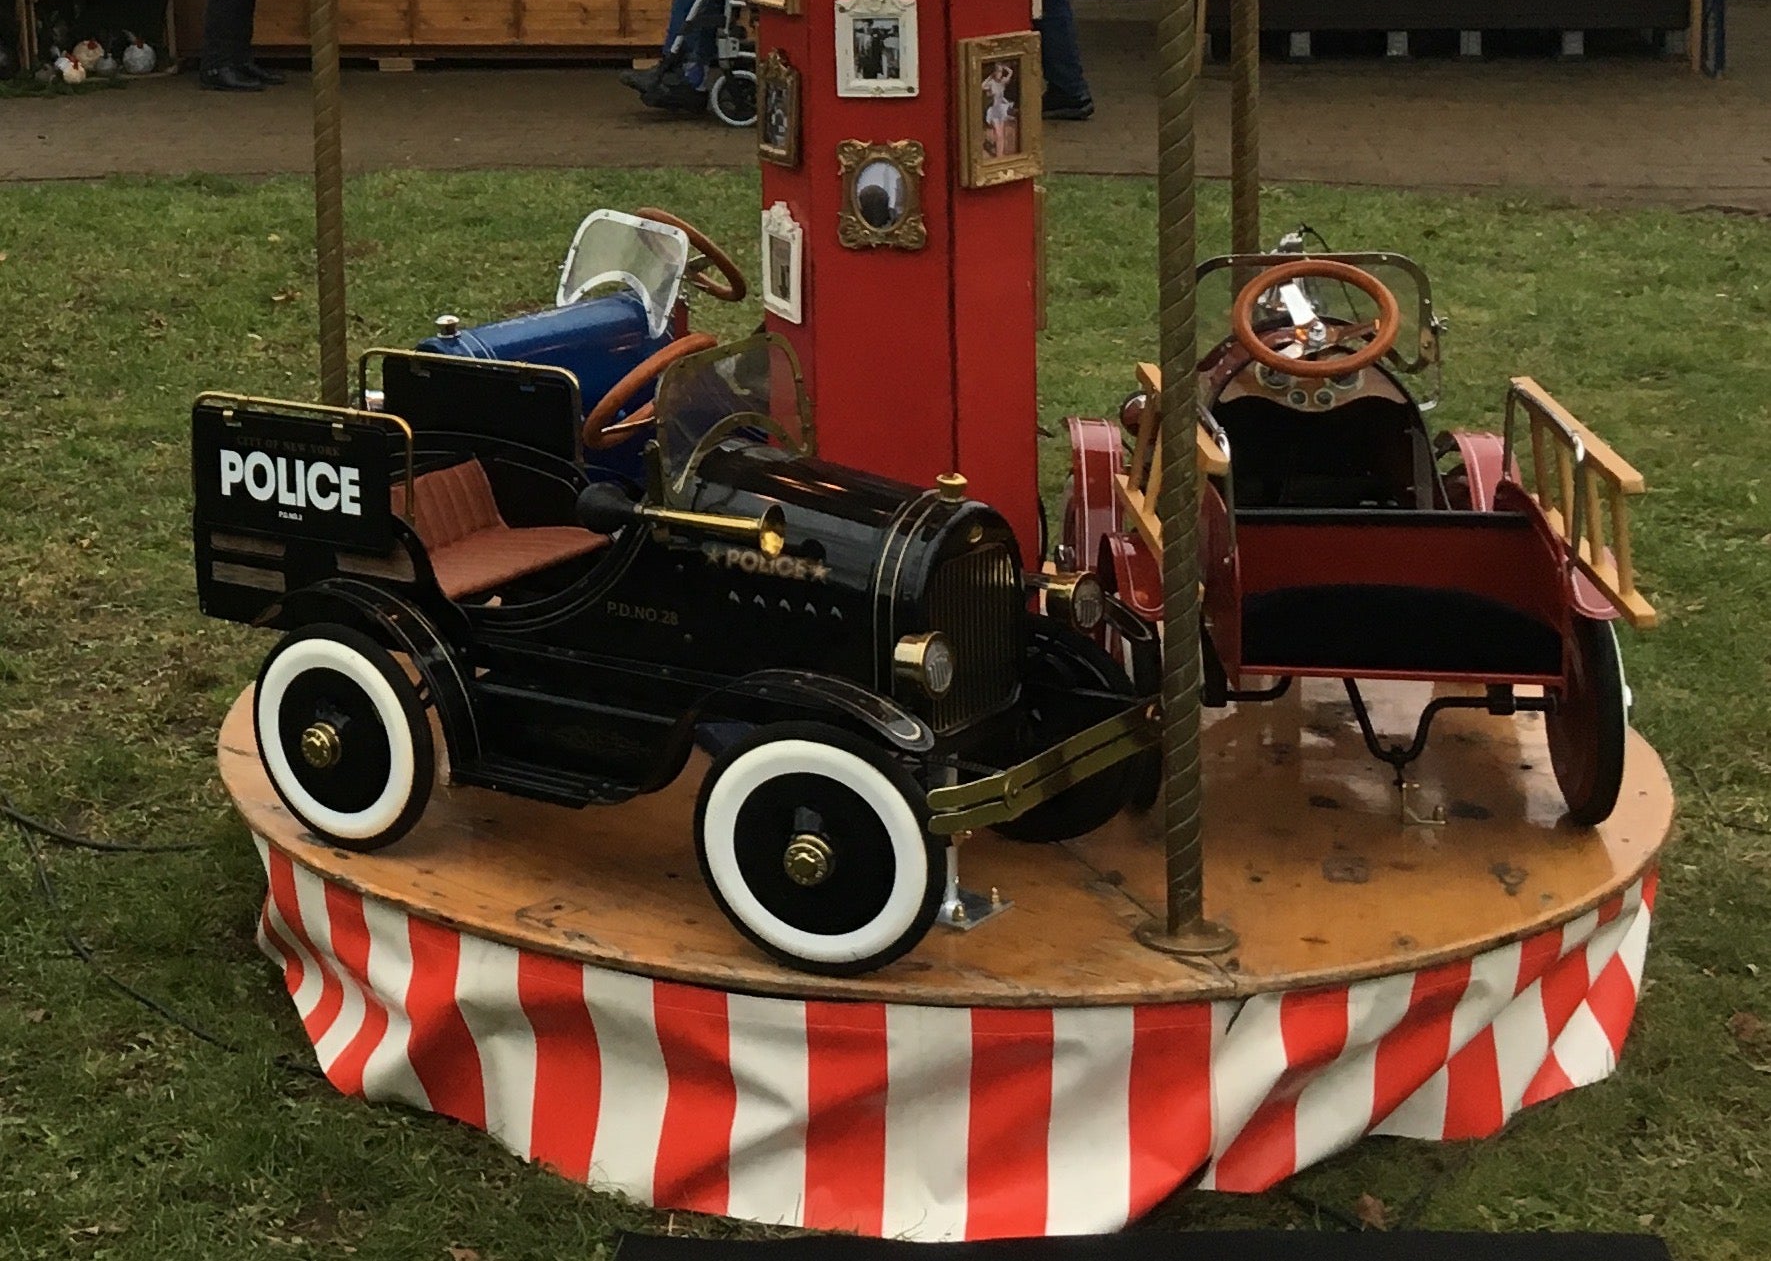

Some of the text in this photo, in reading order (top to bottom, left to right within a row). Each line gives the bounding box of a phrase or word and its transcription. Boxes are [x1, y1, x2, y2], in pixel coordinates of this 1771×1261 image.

[282, 440, 306, 452] NEW
[309, 443, 340, 457] YORK
[219, 448, 362, 516] POLICE
[726, 548, 807, 579] POLICE
